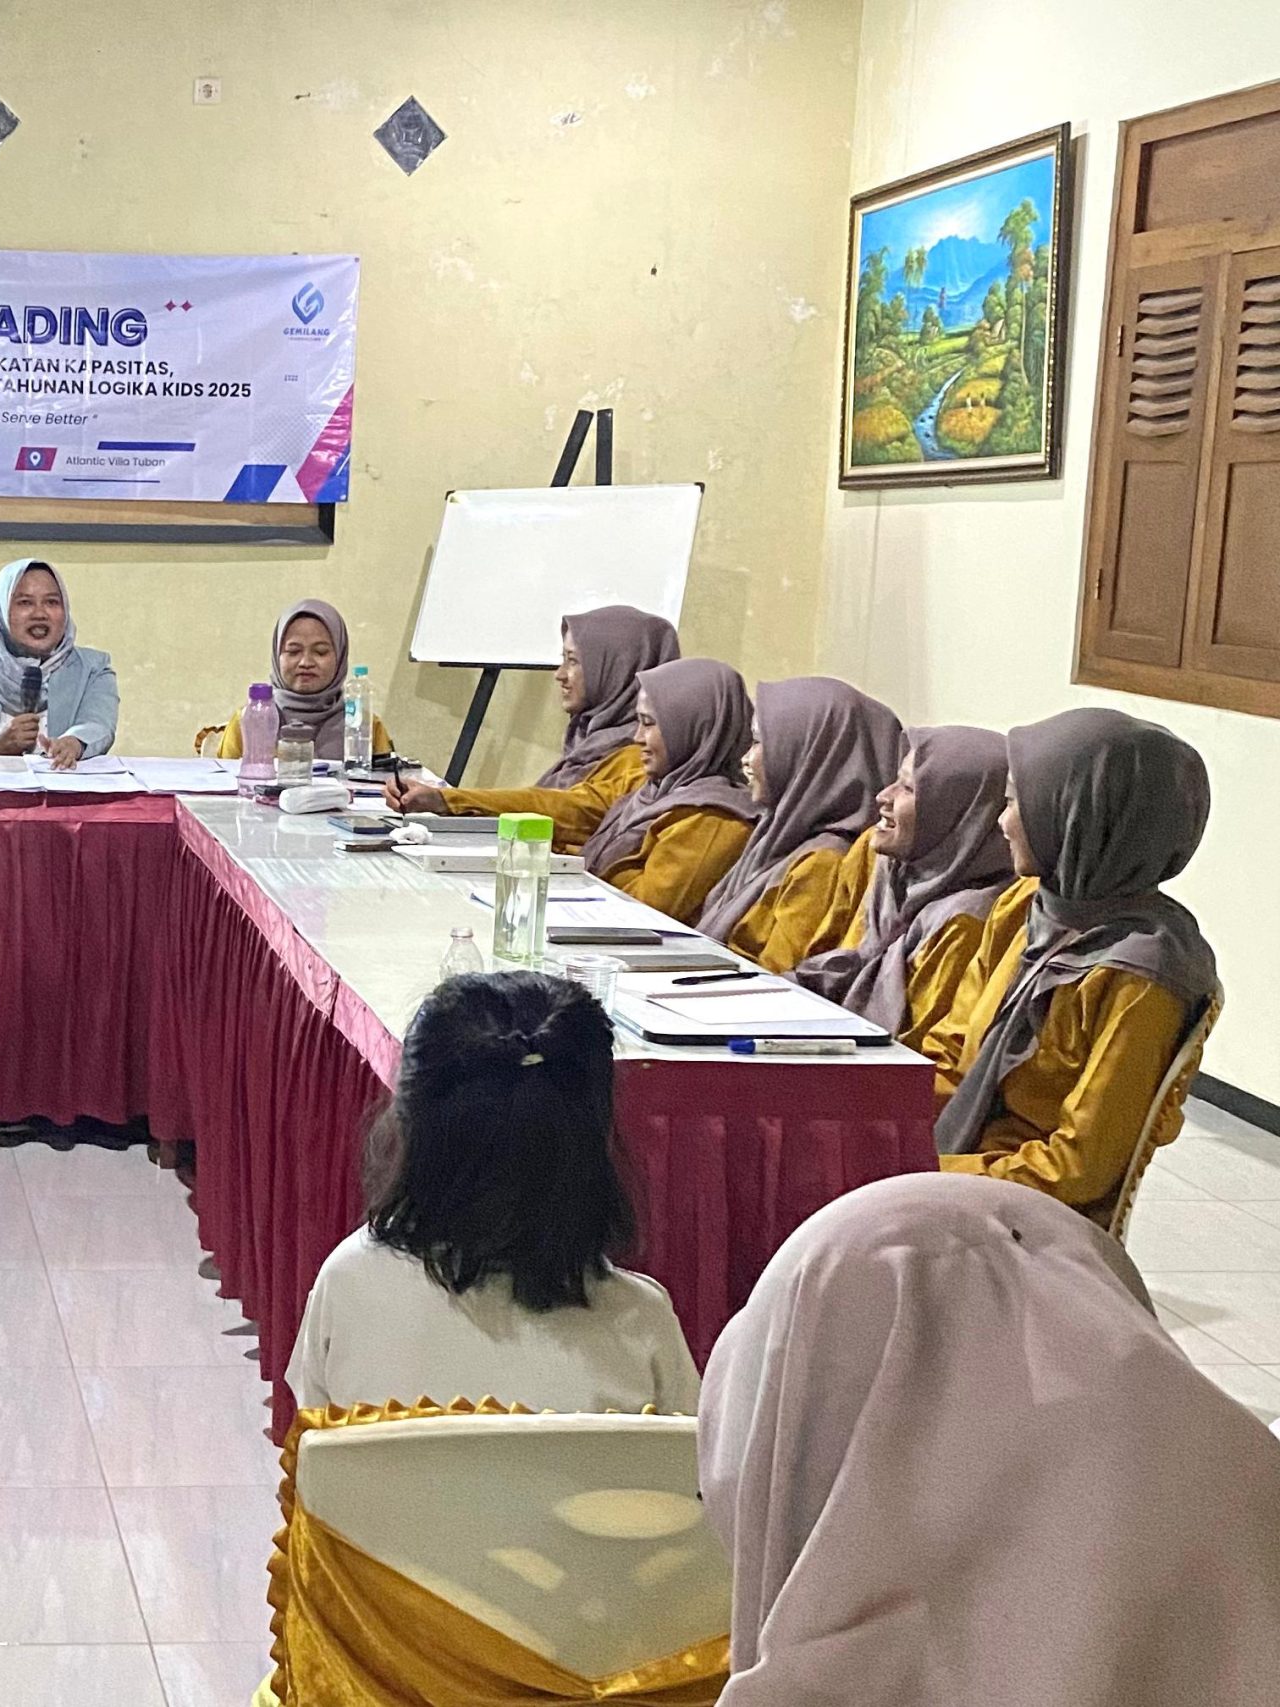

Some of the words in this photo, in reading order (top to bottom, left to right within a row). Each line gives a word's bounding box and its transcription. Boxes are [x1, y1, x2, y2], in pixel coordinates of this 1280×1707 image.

[283, 327, 331, 337] GEMILANG
[65, 358, 174, 378] KAPASITAS,
[89, 380, 158, 397] LOGIKA
[162, 382, 204, 397] KIDS
[208, 382, 252, 398] 2025
[1, 411, 41, 425] Serve
[45, 412, 89, 425] Better
[65, 456, 106, 467] Atlantic
[109, 456, 130, 467] Villa
[133, 457, 166, 467] Tuban
